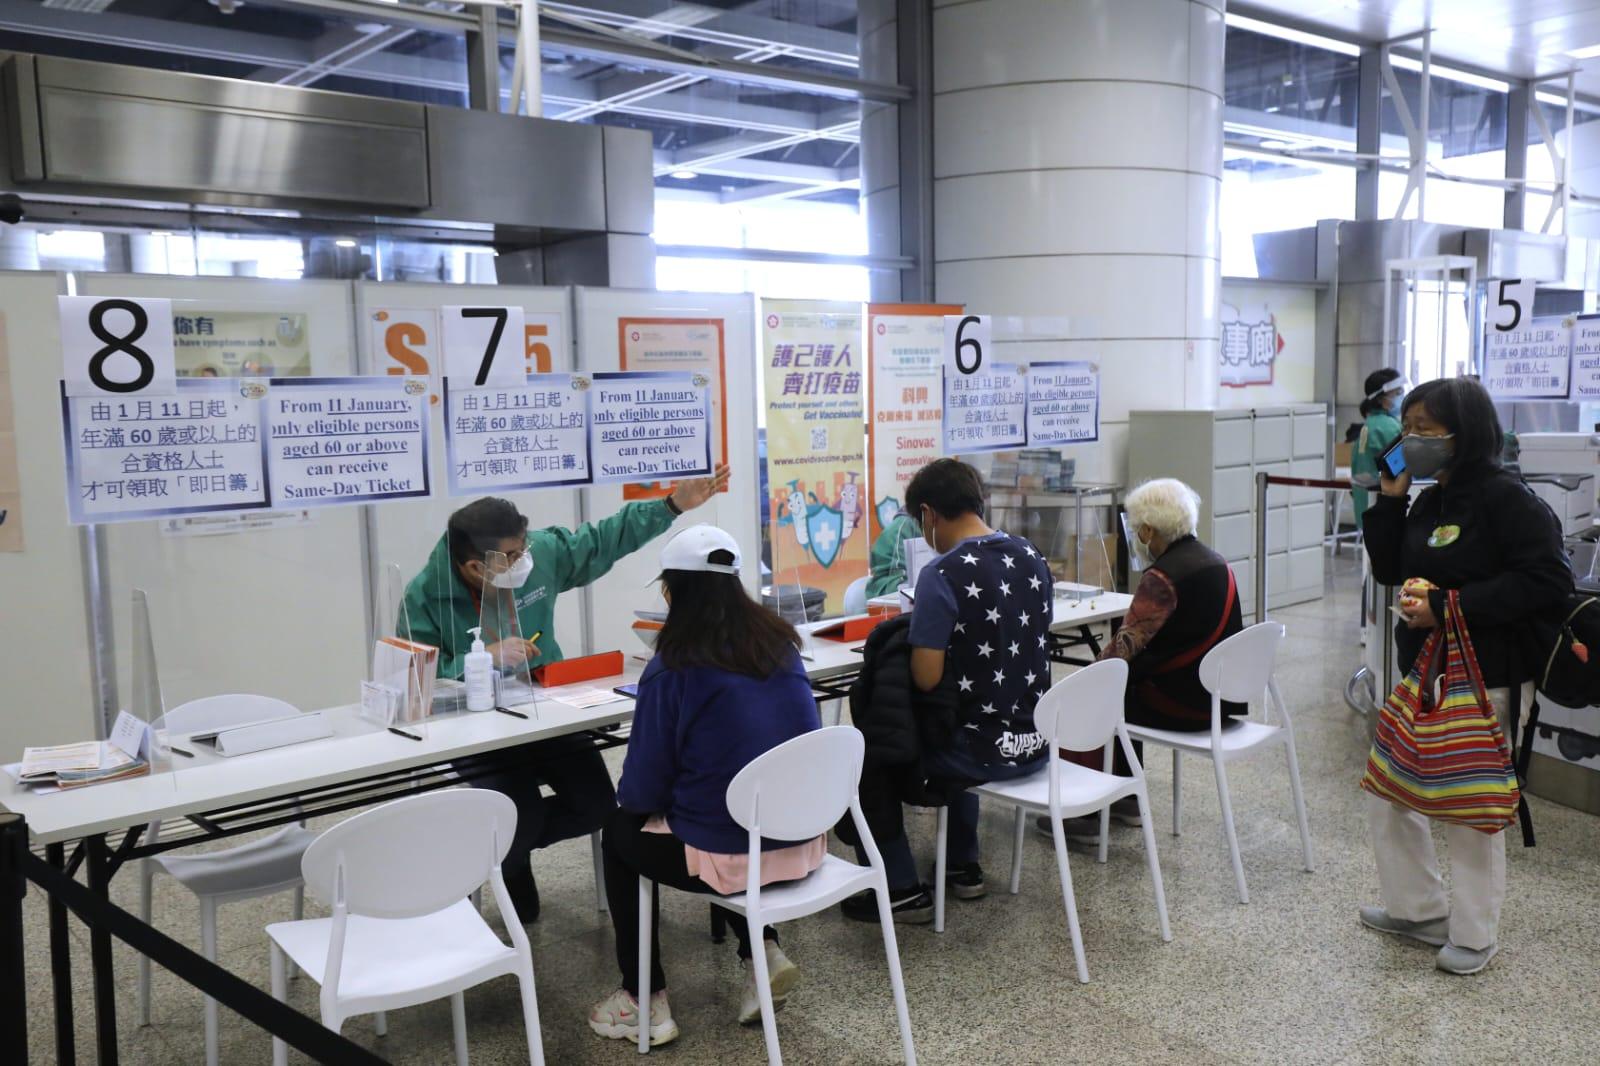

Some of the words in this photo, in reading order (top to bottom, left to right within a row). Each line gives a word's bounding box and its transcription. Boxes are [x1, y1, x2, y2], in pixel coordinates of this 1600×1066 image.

[1495, 279, 1521, 332] 5
[89, 299, 154, 393] 8
[461, 308, 508, 386] 7
[955, 316, 982, 375] 6
[772, 344, 851, 367] 護己護人
[782, 371, 861, 396] 齊打疫苗
[280, 399, 322, 413] From
[328, 399, 341, 412] 11
[348, 397, 412, 412] January,
[463, 394, 478, 411] 由
[600, 391, 632, 403] From
[635, 390, 646, 401] 11
[650, 389, 698, 401] January,
[91, 402, 110, 421] 由
[619, 408, 660, 421] eligible
[663, 407, 704, 420] persons
[307, 419, 360, 435] eligible
[364, 419, 419, 434] persons
[491, 417, 506, 429] 60
[131, 429, 151, 443] 60
[602, 427, 629, 441] aged
[632, 425, 645, 437] 60
[649, 428, 661, 437] or
[664, 424, 696, 436] above
[283, 441, 319, 457] aged
[324, 440, 341, 453] 60
[346, 443, 362, 452] or
[366, 438, 408, 452] above
[484, 434, 559, 453] 合資格人士
[618, 447, 638, 456] can
[642, 442, 680, 455] receive
[896, 437, 936, 449] Sinovac
[122, 450, 224, 471] 合資格人士
[306, 464, 333, 475] can
[339, 459, 388, 474] receive
[602, 461, 659, 476] Same-Day
[662, 458, 697, 471] Ticket
[284, 481, 361, 498] Same-Day
[366, 478, 411, 493] Ticket
